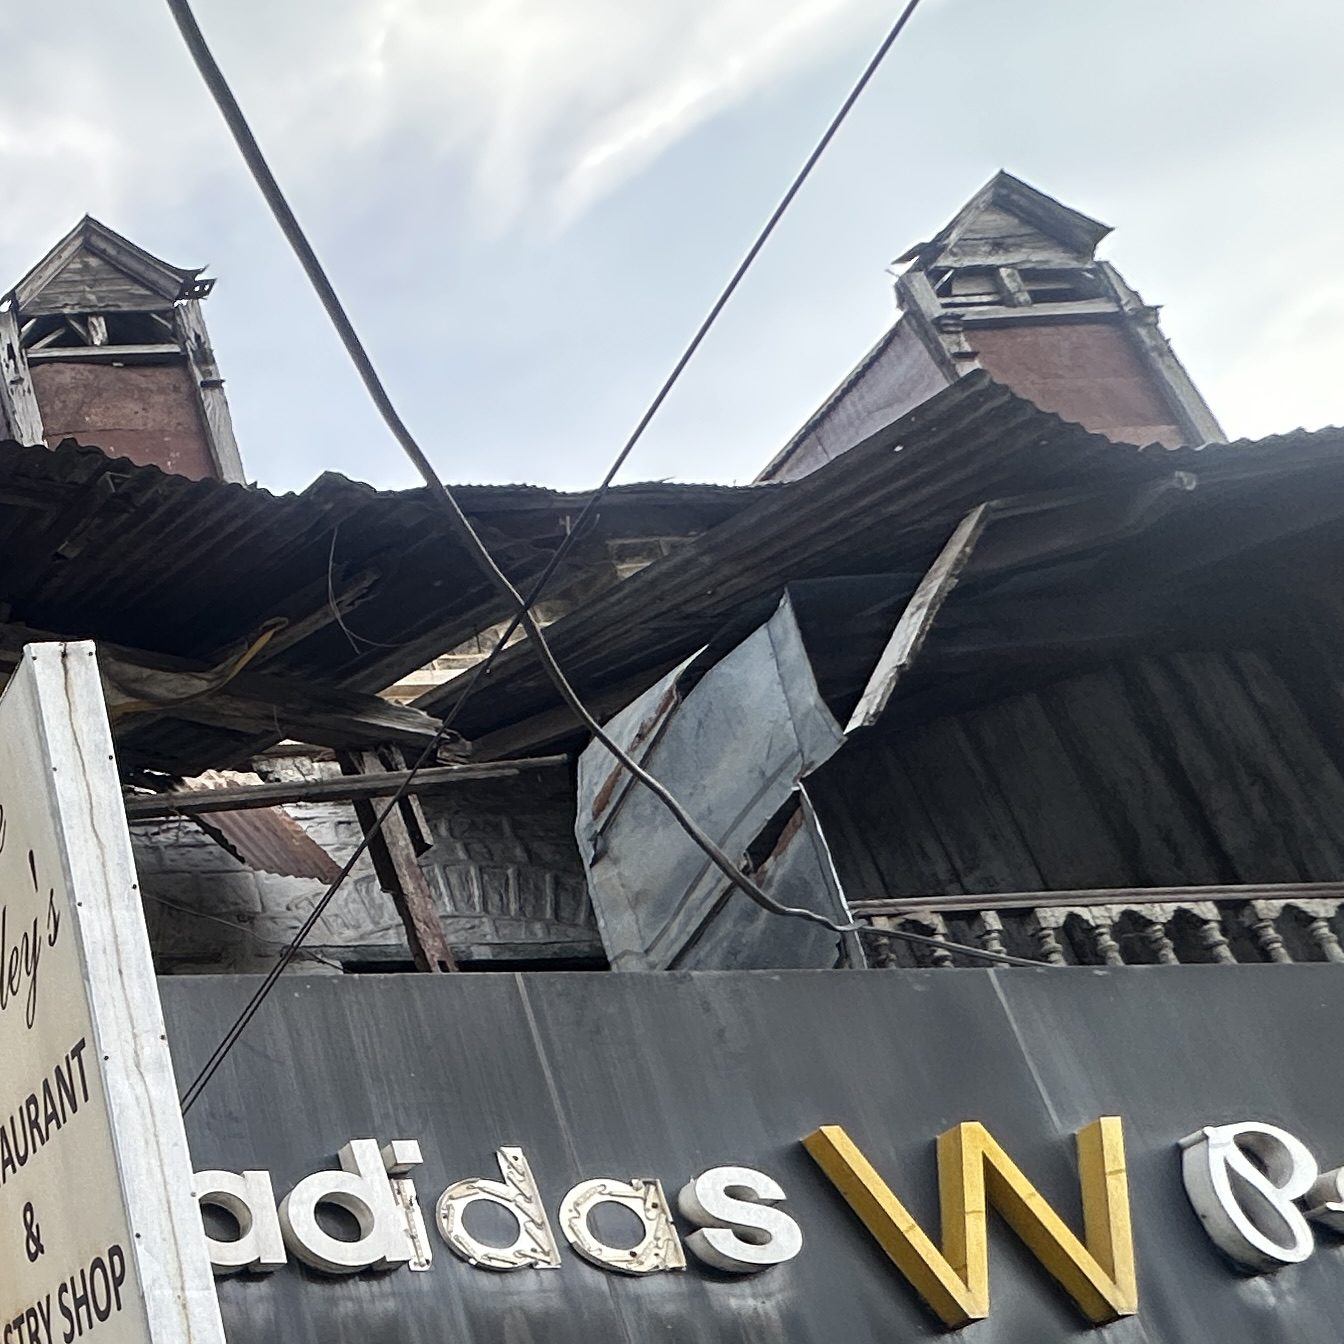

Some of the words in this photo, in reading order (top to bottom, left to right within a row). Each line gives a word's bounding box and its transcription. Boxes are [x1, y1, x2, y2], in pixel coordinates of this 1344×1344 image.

[23, 1202, 45, 1263] &
[190, 1138, 804, 1277] adidas
[814, 1115, 1138, 1321] W
